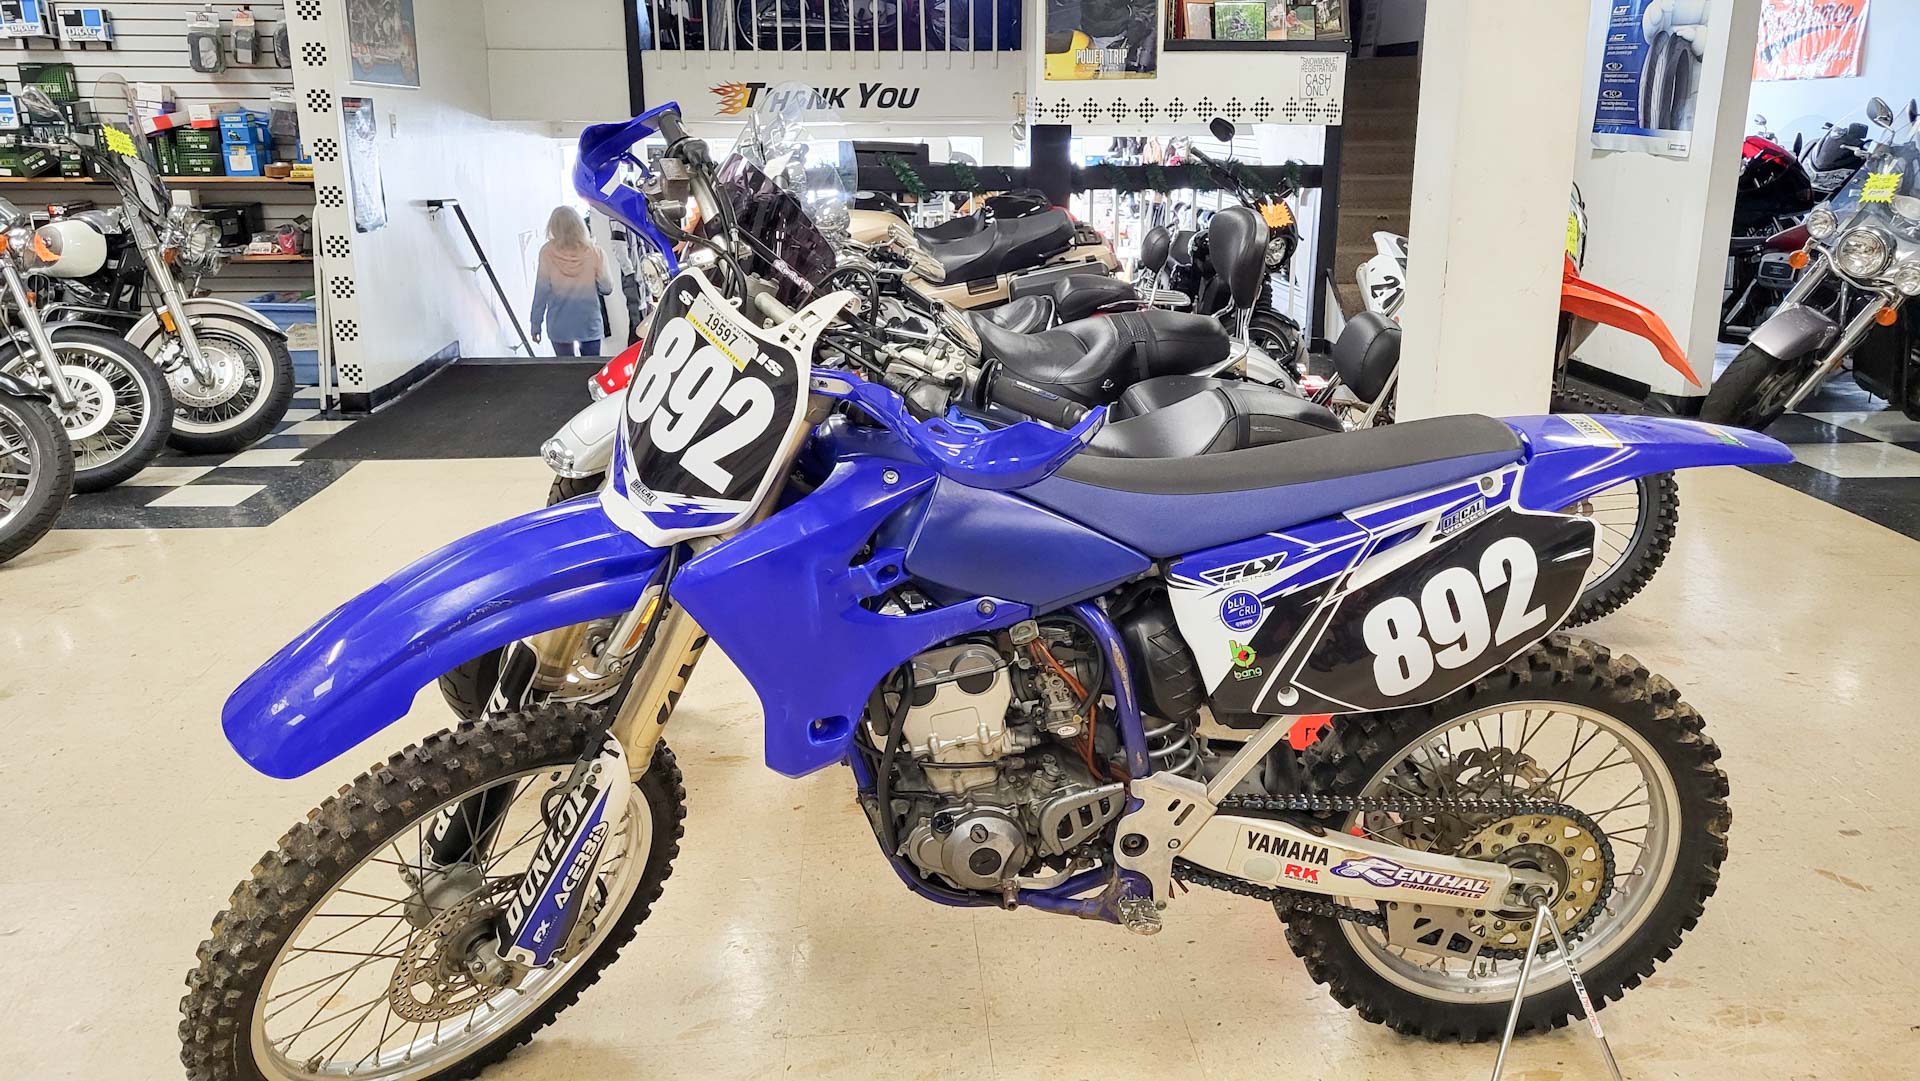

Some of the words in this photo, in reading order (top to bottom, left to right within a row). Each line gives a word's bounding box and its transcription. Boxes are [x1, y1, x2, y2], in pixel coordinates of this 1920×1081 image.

[10, 24, 37, 34] DRAG
[66, 27, 97, 37] DRAG
[1075, 48, 1105, 66] POWER
[1108, 48, 1128, 66] TRIP
[1301, 64, 1338, 72] REGISTRATION
[1305, 73, 1332, 85] CASH
[1305, 85, 1331, 97] ONLY
[746, 82, 851, 113] THANK
[858, 82, 920, 108] YOU
[704, 313, 739, 347] 19597
[716, 311, 752, 345] HAMPSHIRE
[627, 316, 776, 495] 892
[1443, 501, 1483, 529] DECAL
[1204, 553, 1286, 582] FLY
[1223, 571, 1273, 587] RACING
[1362, 536, 1547, 697] 892
[1234, 666, 1263, 680] bang
[504, 784, 591, 937] DUNLOP
[1247, 830, 1330, 866] YAMAHA
[553, 821, 608, 910] ACERBIS
[1284, 863, 1320, 881] RK
[1401, 882, 1482, 899] CHAINWHEELS
[532, 920, 551, 943] FX
[1566, 960, 1585, 995] EXCEL
